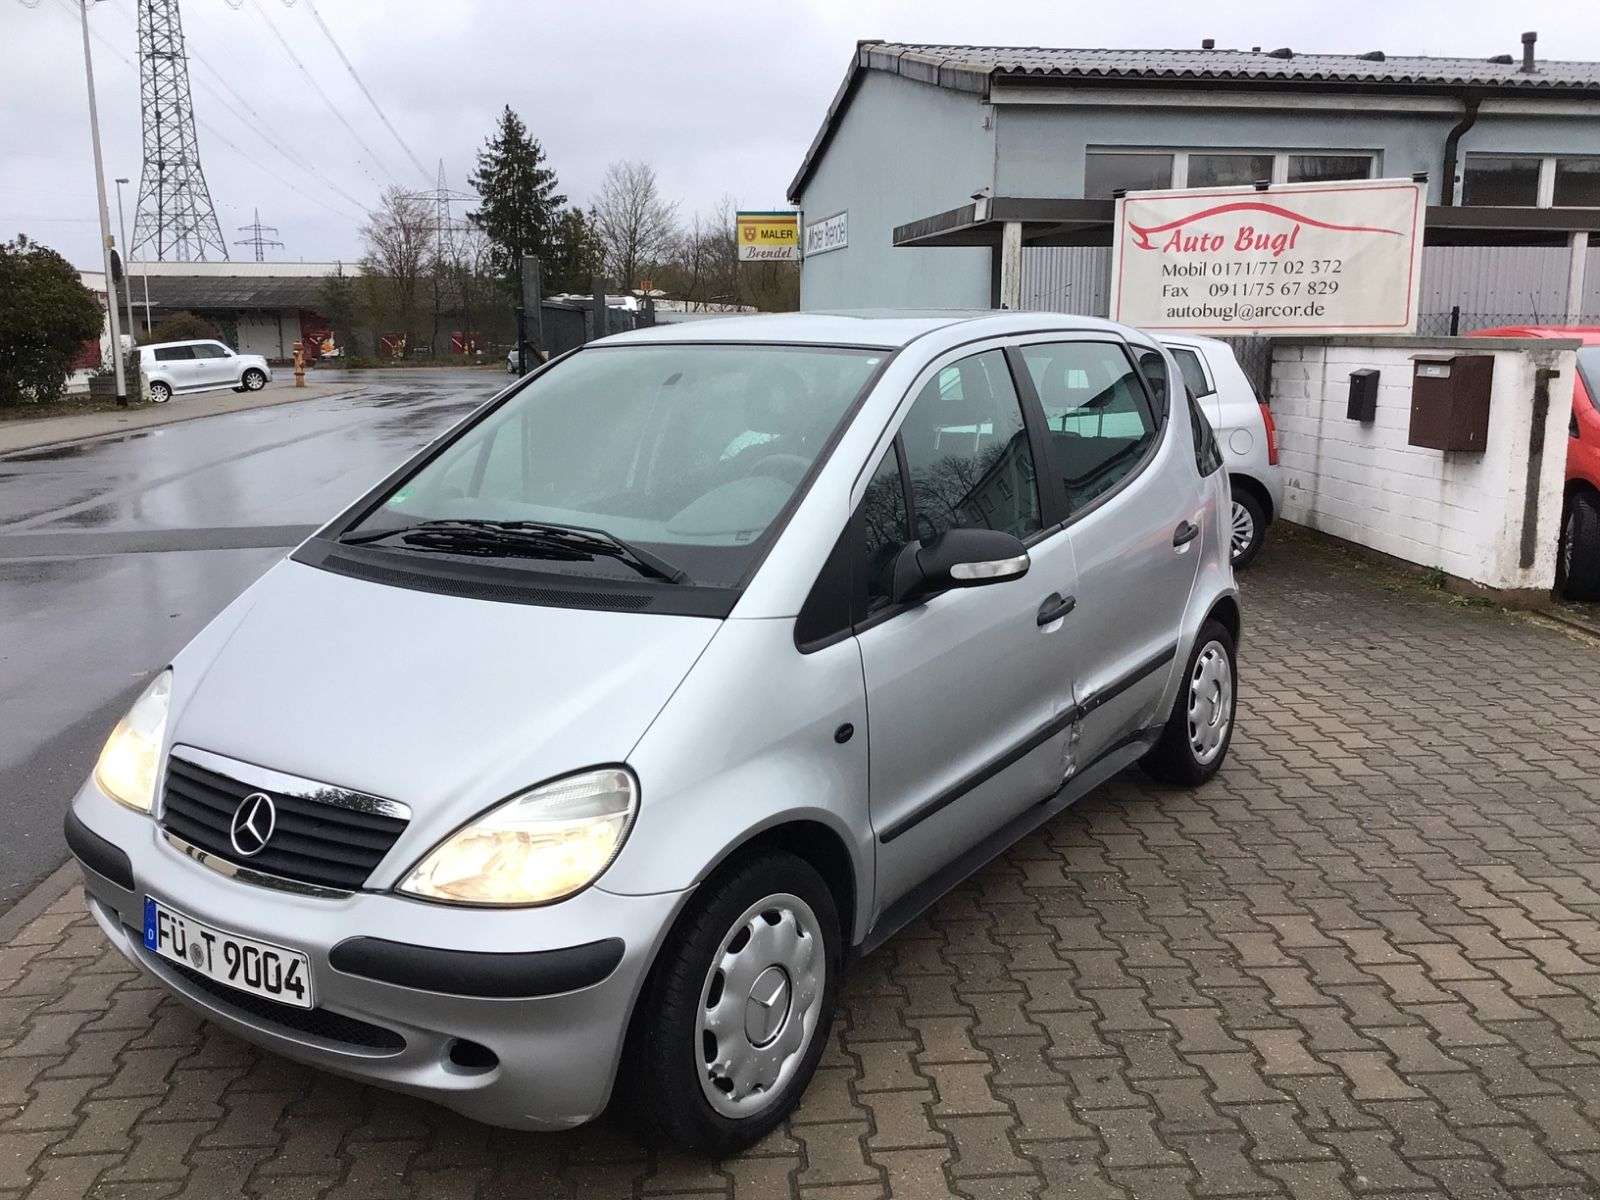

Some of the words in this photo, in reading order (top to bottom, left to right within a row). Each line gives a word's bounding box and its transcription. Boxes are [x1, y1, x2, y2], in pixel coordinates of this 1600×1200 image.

[760, 229, 793, 239] MALER
[1163, 228, 1224, 253] Auto
[1234, 223, 1300, 257] Bugl
[745, 246, 792, 259] Brendel
[1162, 262, 1206, 277] Mobil
[1211, 261, 1278, 276] 0171/77
[1283, 260, 1304, 274] 02
[1310, 259, 1342, 274] 372
[1162, 284, 1189, 297] Fax
[1209, 282, 1275, 297] 0911/75
[1280, 281, 1301, 295] 67
[1307, 280, 1339, 295] 829
[1166, 301, 1325, 322] autobugl@arcor.de
[148, 928, 154, 941] D
[157, 910, 187, 960] FÜ
[200, 930, 216, 972] T
[223, 941, 305, 1000] 9004
